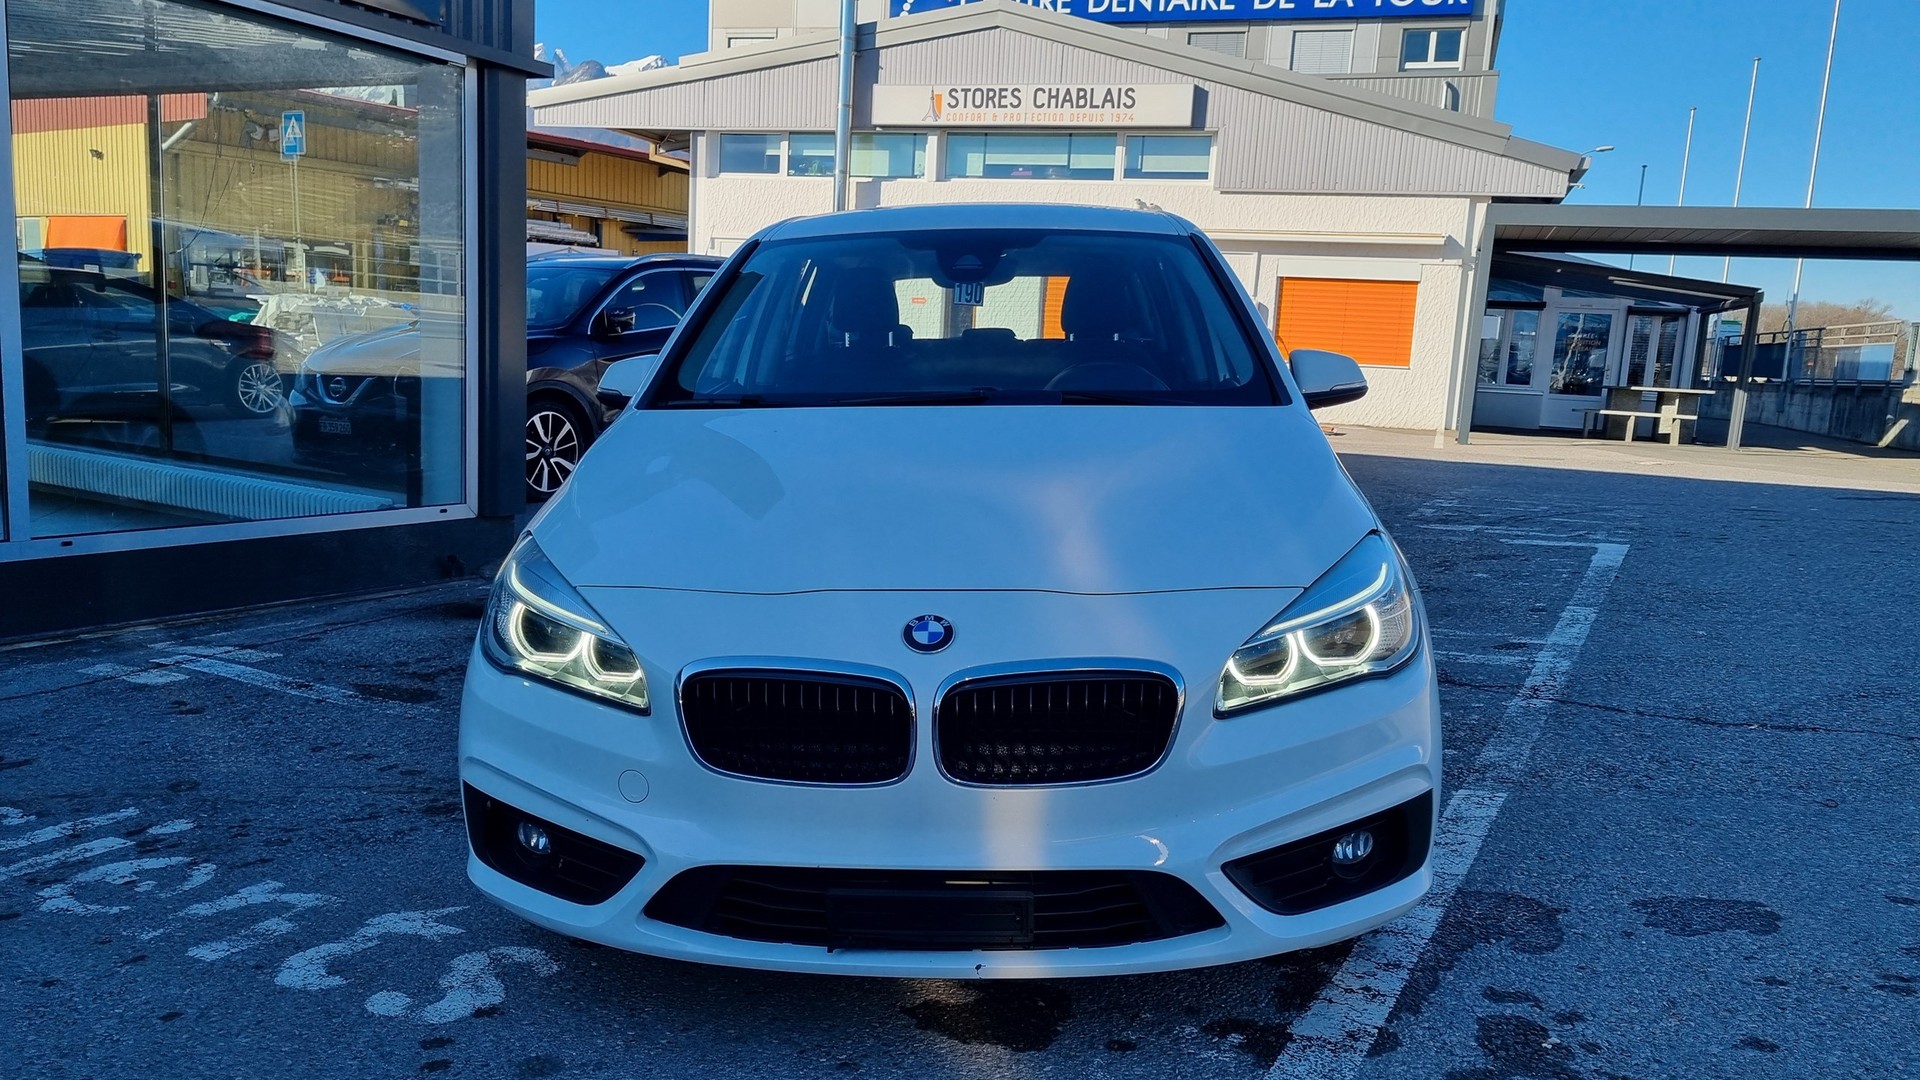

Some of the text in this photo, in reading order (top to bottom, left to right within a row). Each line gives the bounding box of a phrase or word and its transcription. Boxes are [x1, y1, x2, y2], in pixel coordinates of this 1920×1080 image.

[946, 87, 1136, 109] STORES CHABLAIS
[946, 112, 987, 121] CONFORT
[992, 112, 998, 121] &
[1069, 112, 1105, 122] DEPUIS
[1110, 112, 1134, 122] 1974
[955, 282, 983, 304] 190
[908, 615, 951, 627] BMW
[0, 806, 561, 1024] lients
